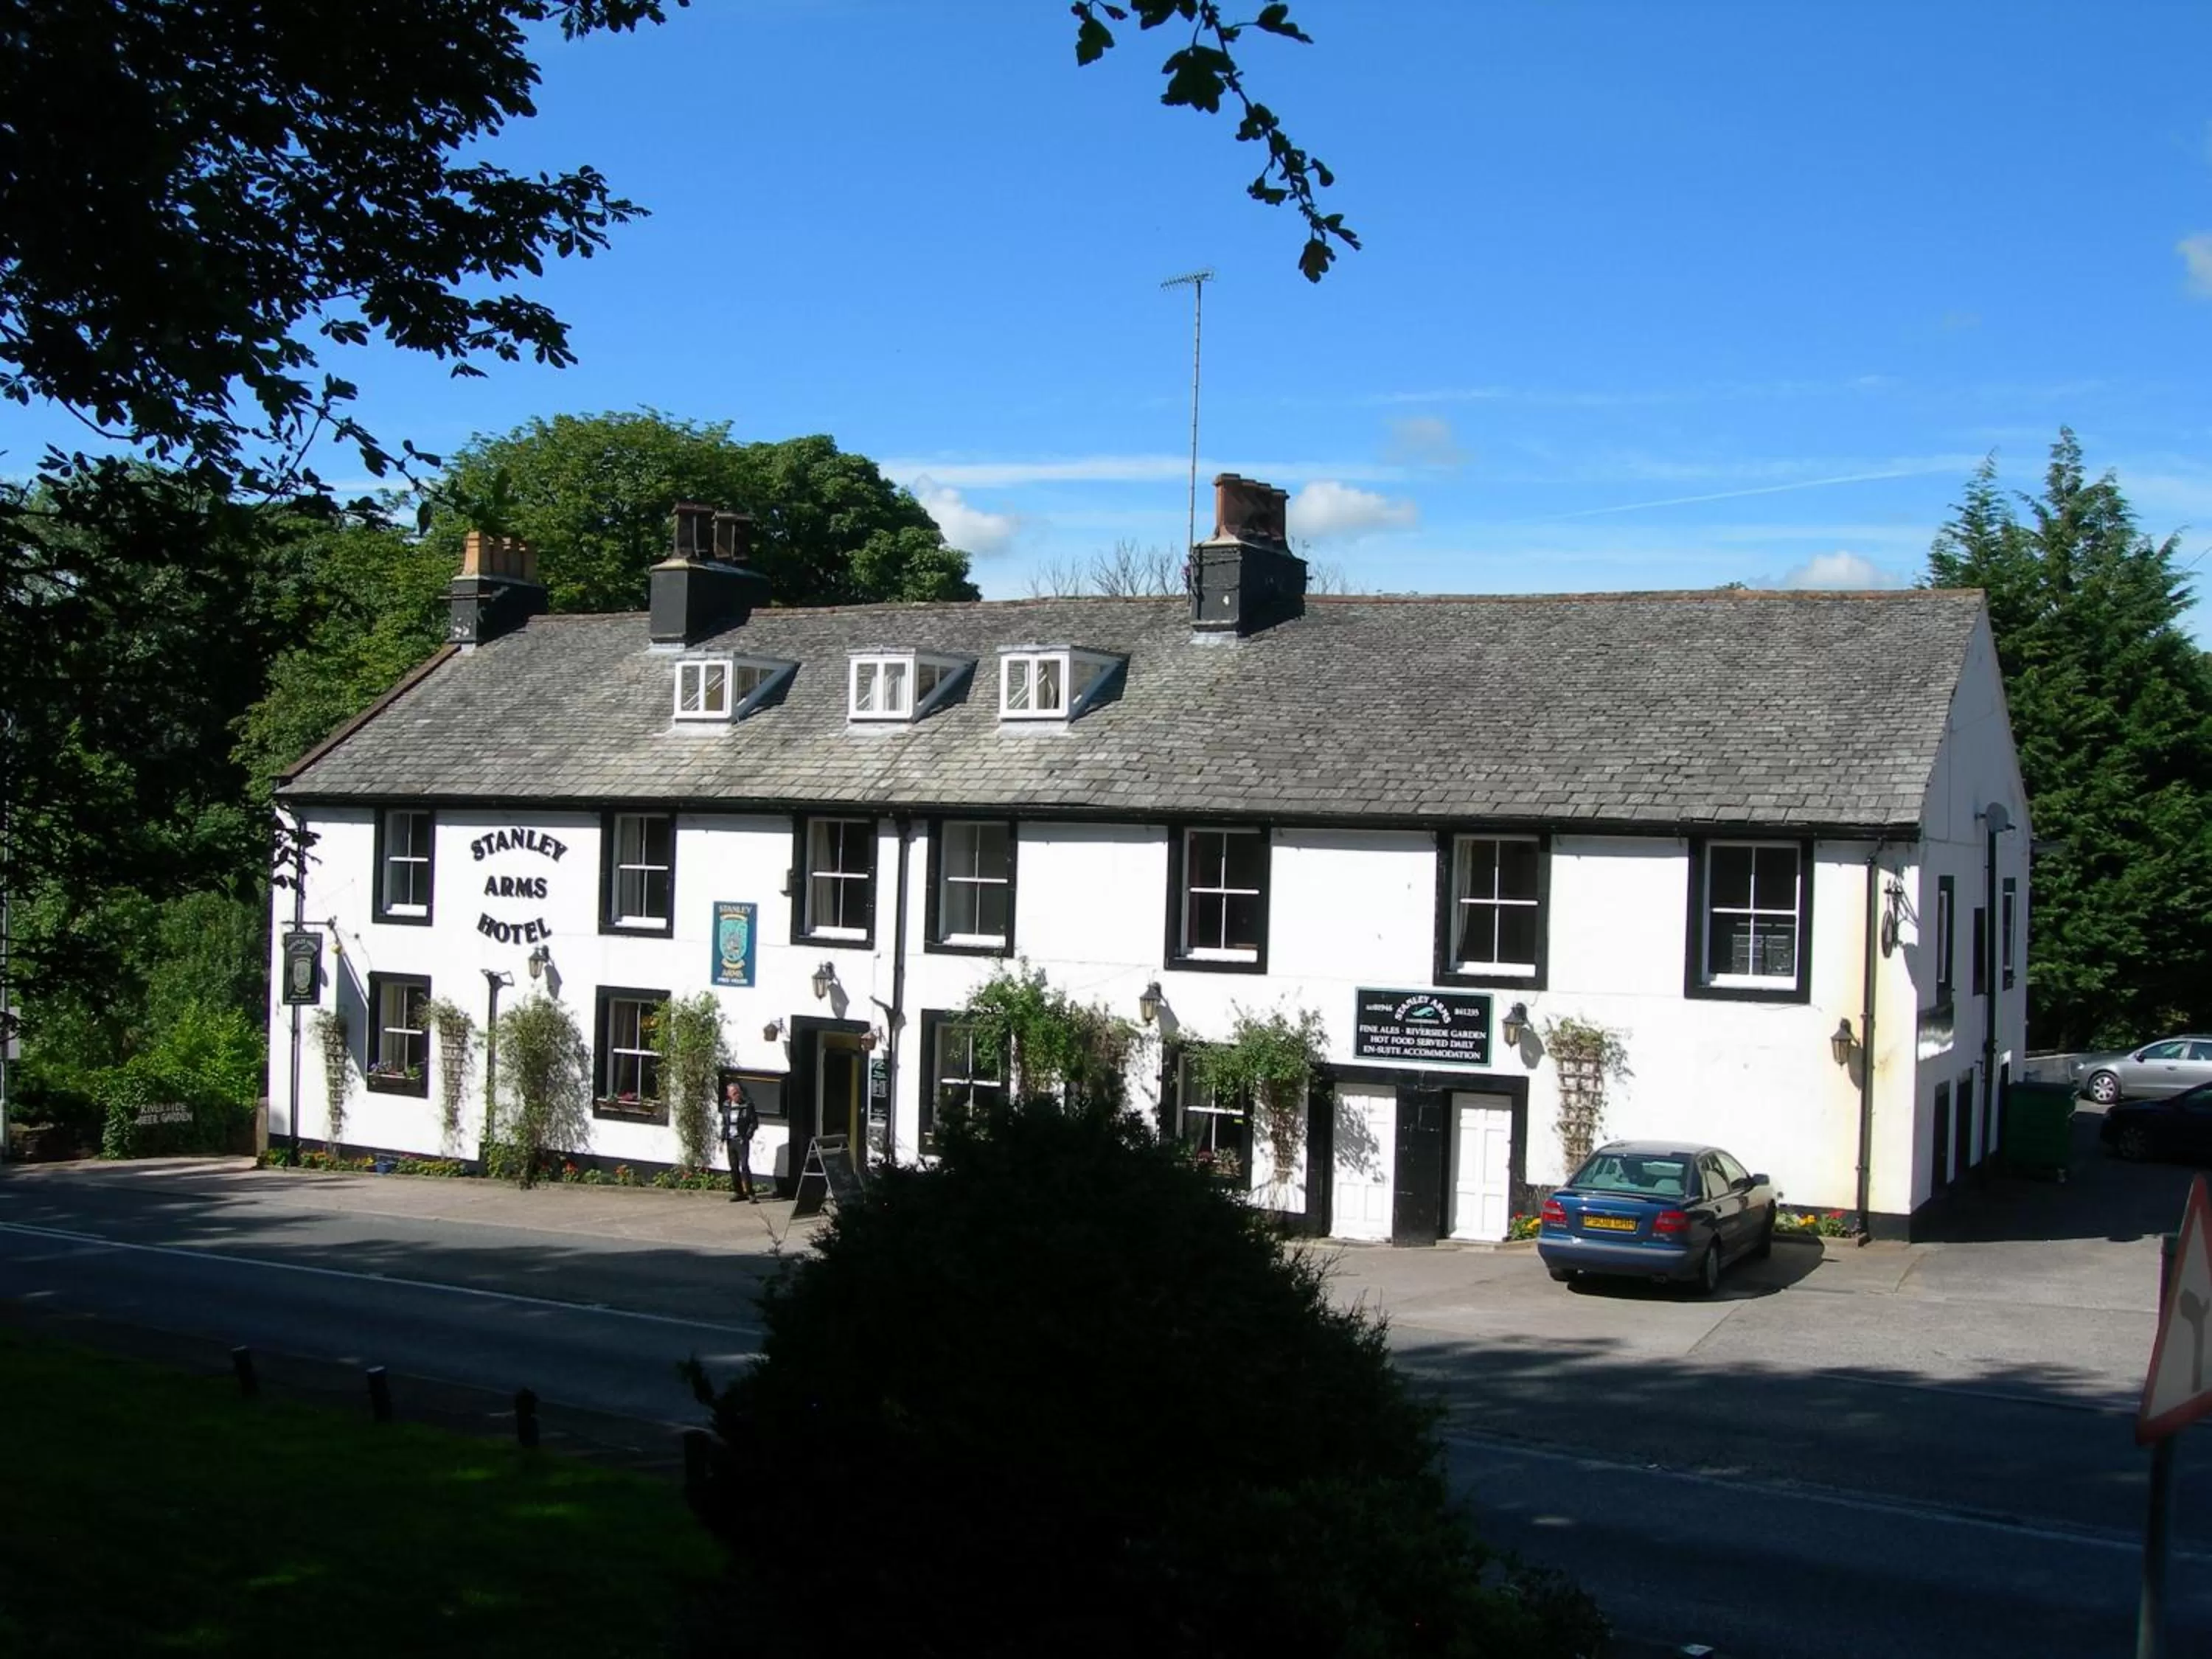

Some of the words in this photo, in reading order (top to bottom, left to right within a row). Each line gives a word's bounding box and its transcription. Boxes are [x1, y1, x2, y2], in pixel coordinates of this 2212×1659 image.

[470, 828, 568, 862] STANLEY
[484, 875, 548, 899] ARMS
[477, 912, 552, 945] HOTEL
[1394, 995, 1430, 1021] STANLEY
[1430, 998, 1452, 1024] ARMS
[1359, 1024, 1378, 1033] FINE
[1380, 1026, 1400, 1034] ALES
[1405, 1027, 1449, 1037] RIVERSIDE
[1450, 1030, 1487, 1040] GARDEN
[1370, 1035, 1390, 1044] HOT
[1391, 1036, 1415, 1045] FOOD
[1416, 1038, 1449, 1048] SERVED
[1450, 1040, 1475, 1048] DAILY
[1363, 1045, 1401, 1055] EN-SUITE
[1402, 1047, 1481, 1060] ACCOMMODATION
[161, 1112, 193, 1124] GARDEN
